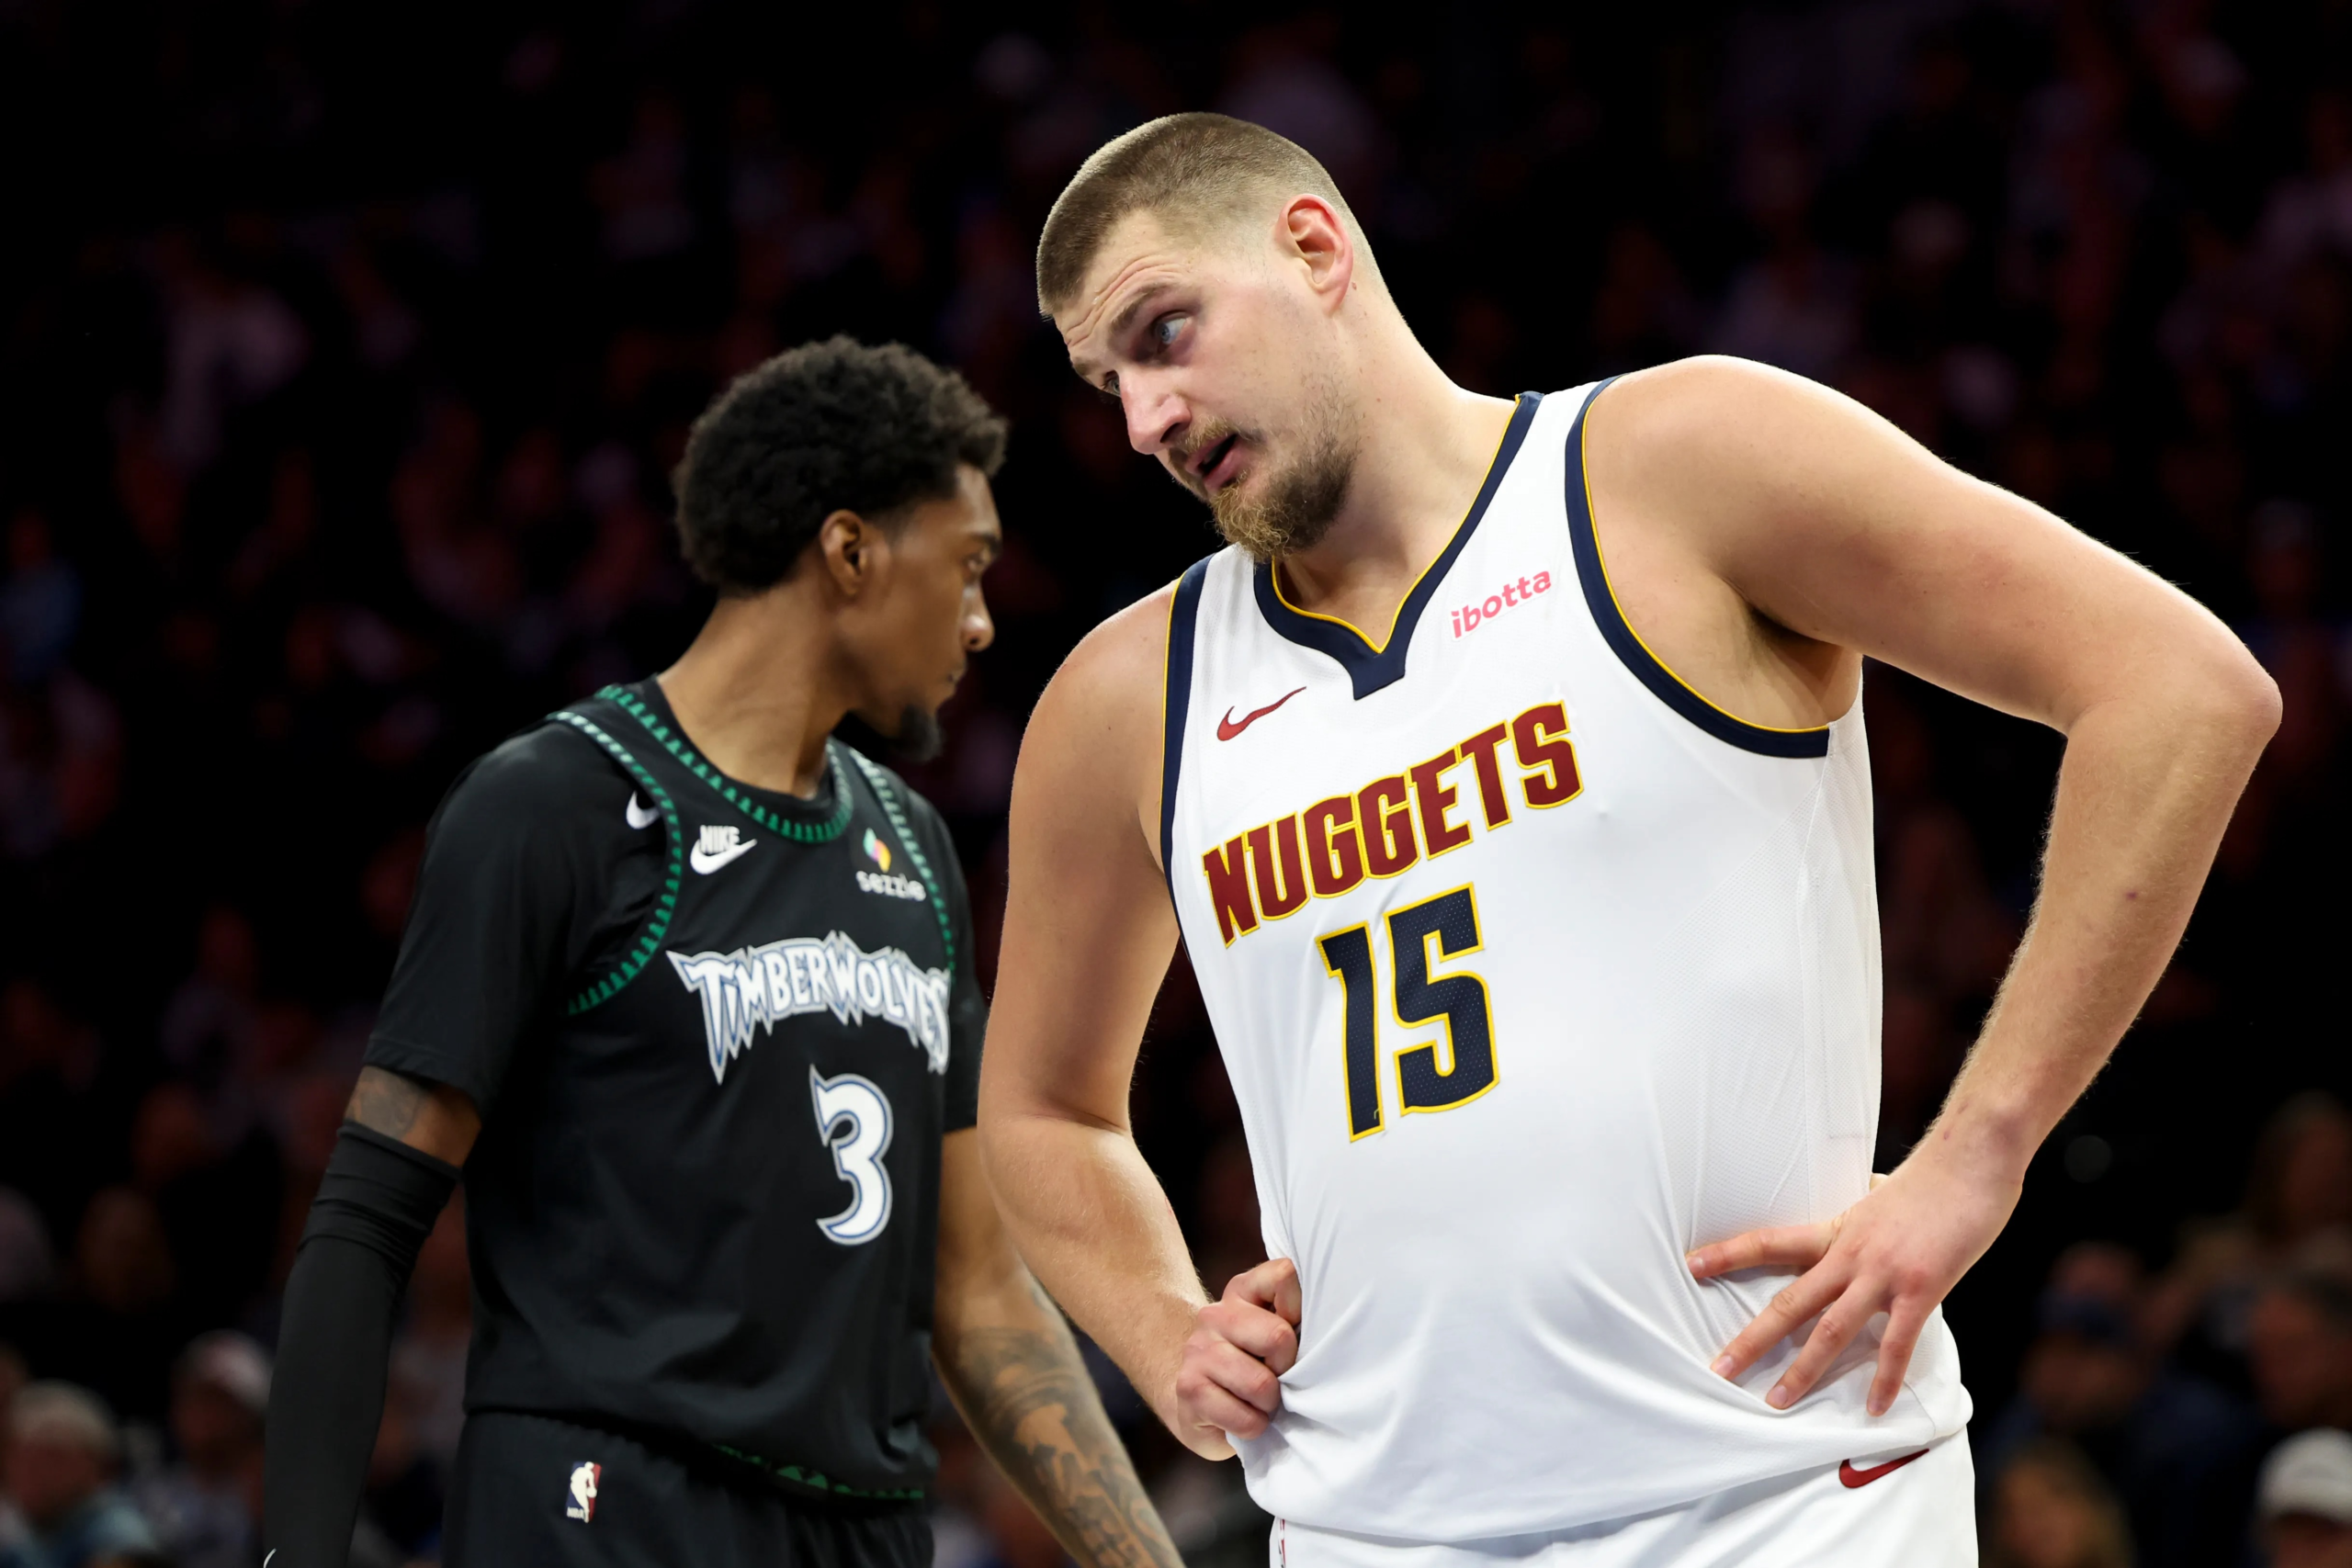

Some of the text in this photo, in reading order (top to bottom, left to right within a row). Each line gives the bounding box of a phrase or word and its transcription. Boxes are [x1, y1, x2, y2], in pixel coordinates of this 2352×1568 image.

[1451, 570, 1552, 638] ibotta
[699, 824, 741, 853] NIKE
[855, 870, 926, 902] sezzle
[1202, 700, 1584, 949] NUGGETS
[665, 930, 952, 1084] TIMBERWOLVES
[1315, 882, 1500, 1143] 15
[808, 1064, 894, 1246] 3
